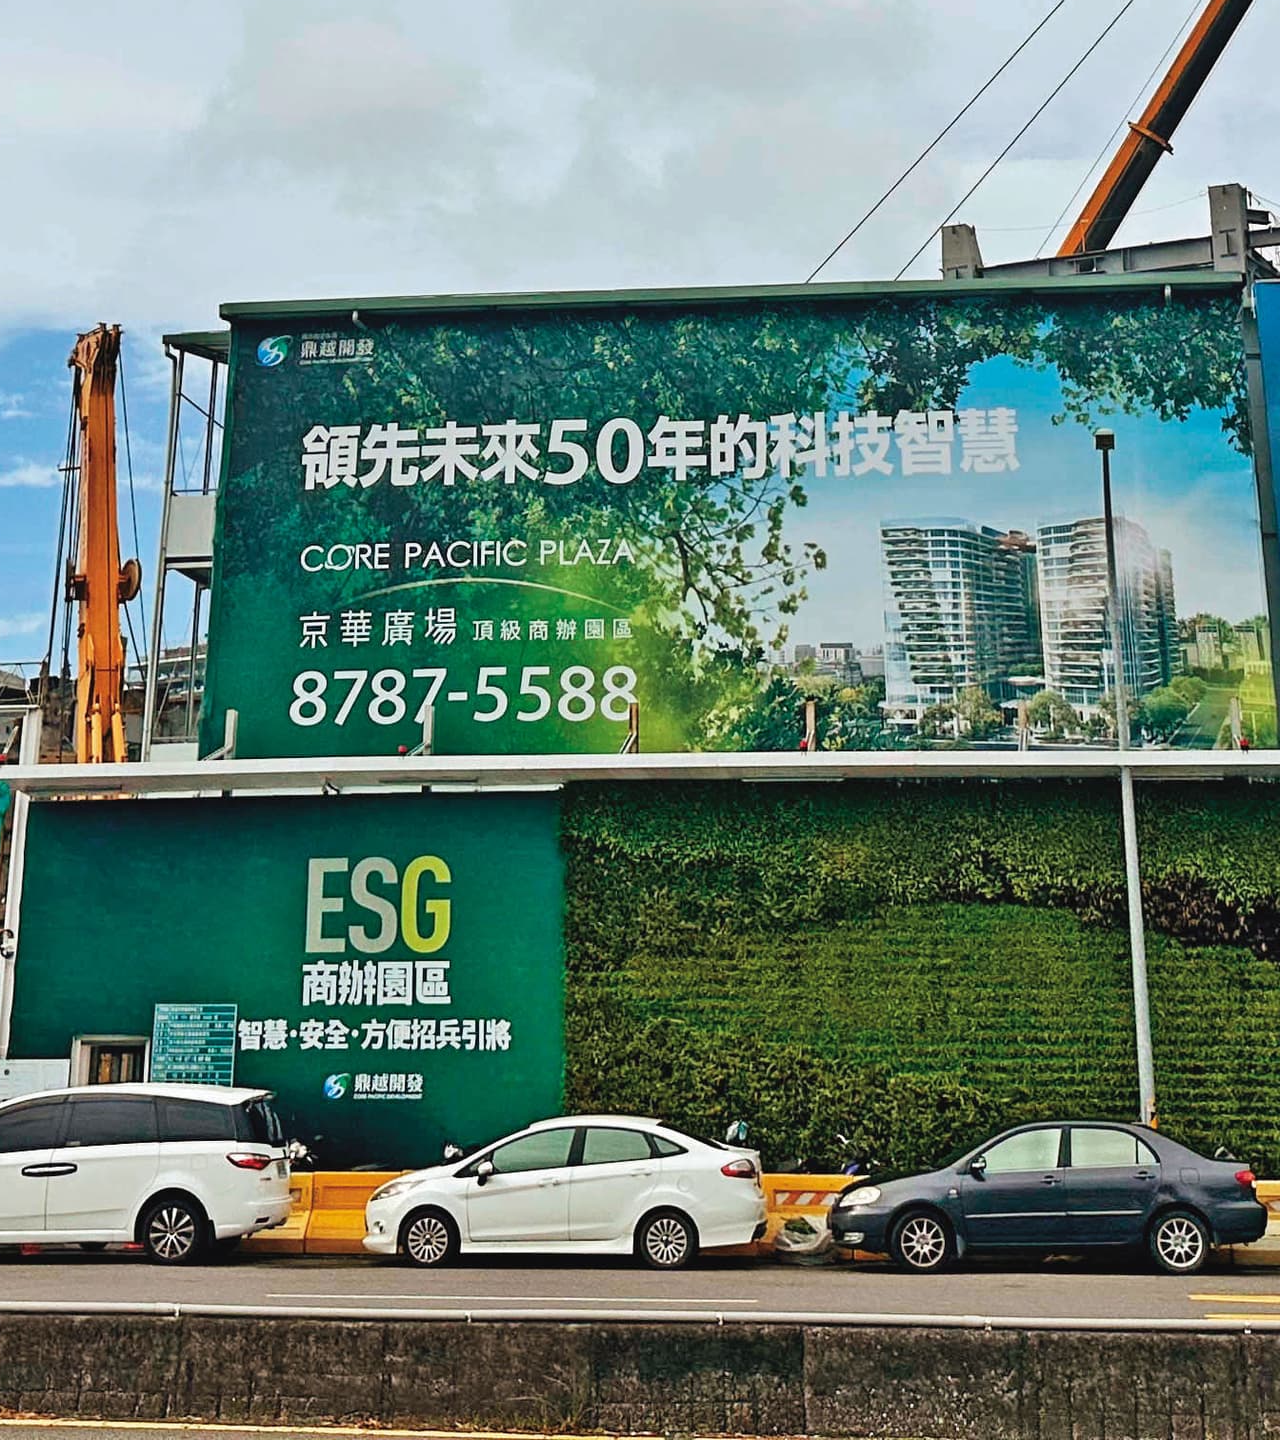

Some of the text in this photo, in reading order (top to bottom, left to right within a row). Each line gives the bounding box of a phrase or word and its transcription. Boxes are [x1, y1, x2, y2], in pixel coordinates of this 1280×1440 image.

[300, 339, 375, 359] 鼎越開發
[302, 407, 1020, 490] 領先未來50年的科技智慧
[300, 539, 636, 572] CORE PACIFIC PLAZA
[299, 607, 633, 649] 京華廣場 頂級商辦園區
[289, 665, 637, 727] 8787-5588
[305, 855, 451, 954] ESG
[302, 960, 452, 1006] 商辦園區
[354, 1073, 423, 1093] 鼎越開發
